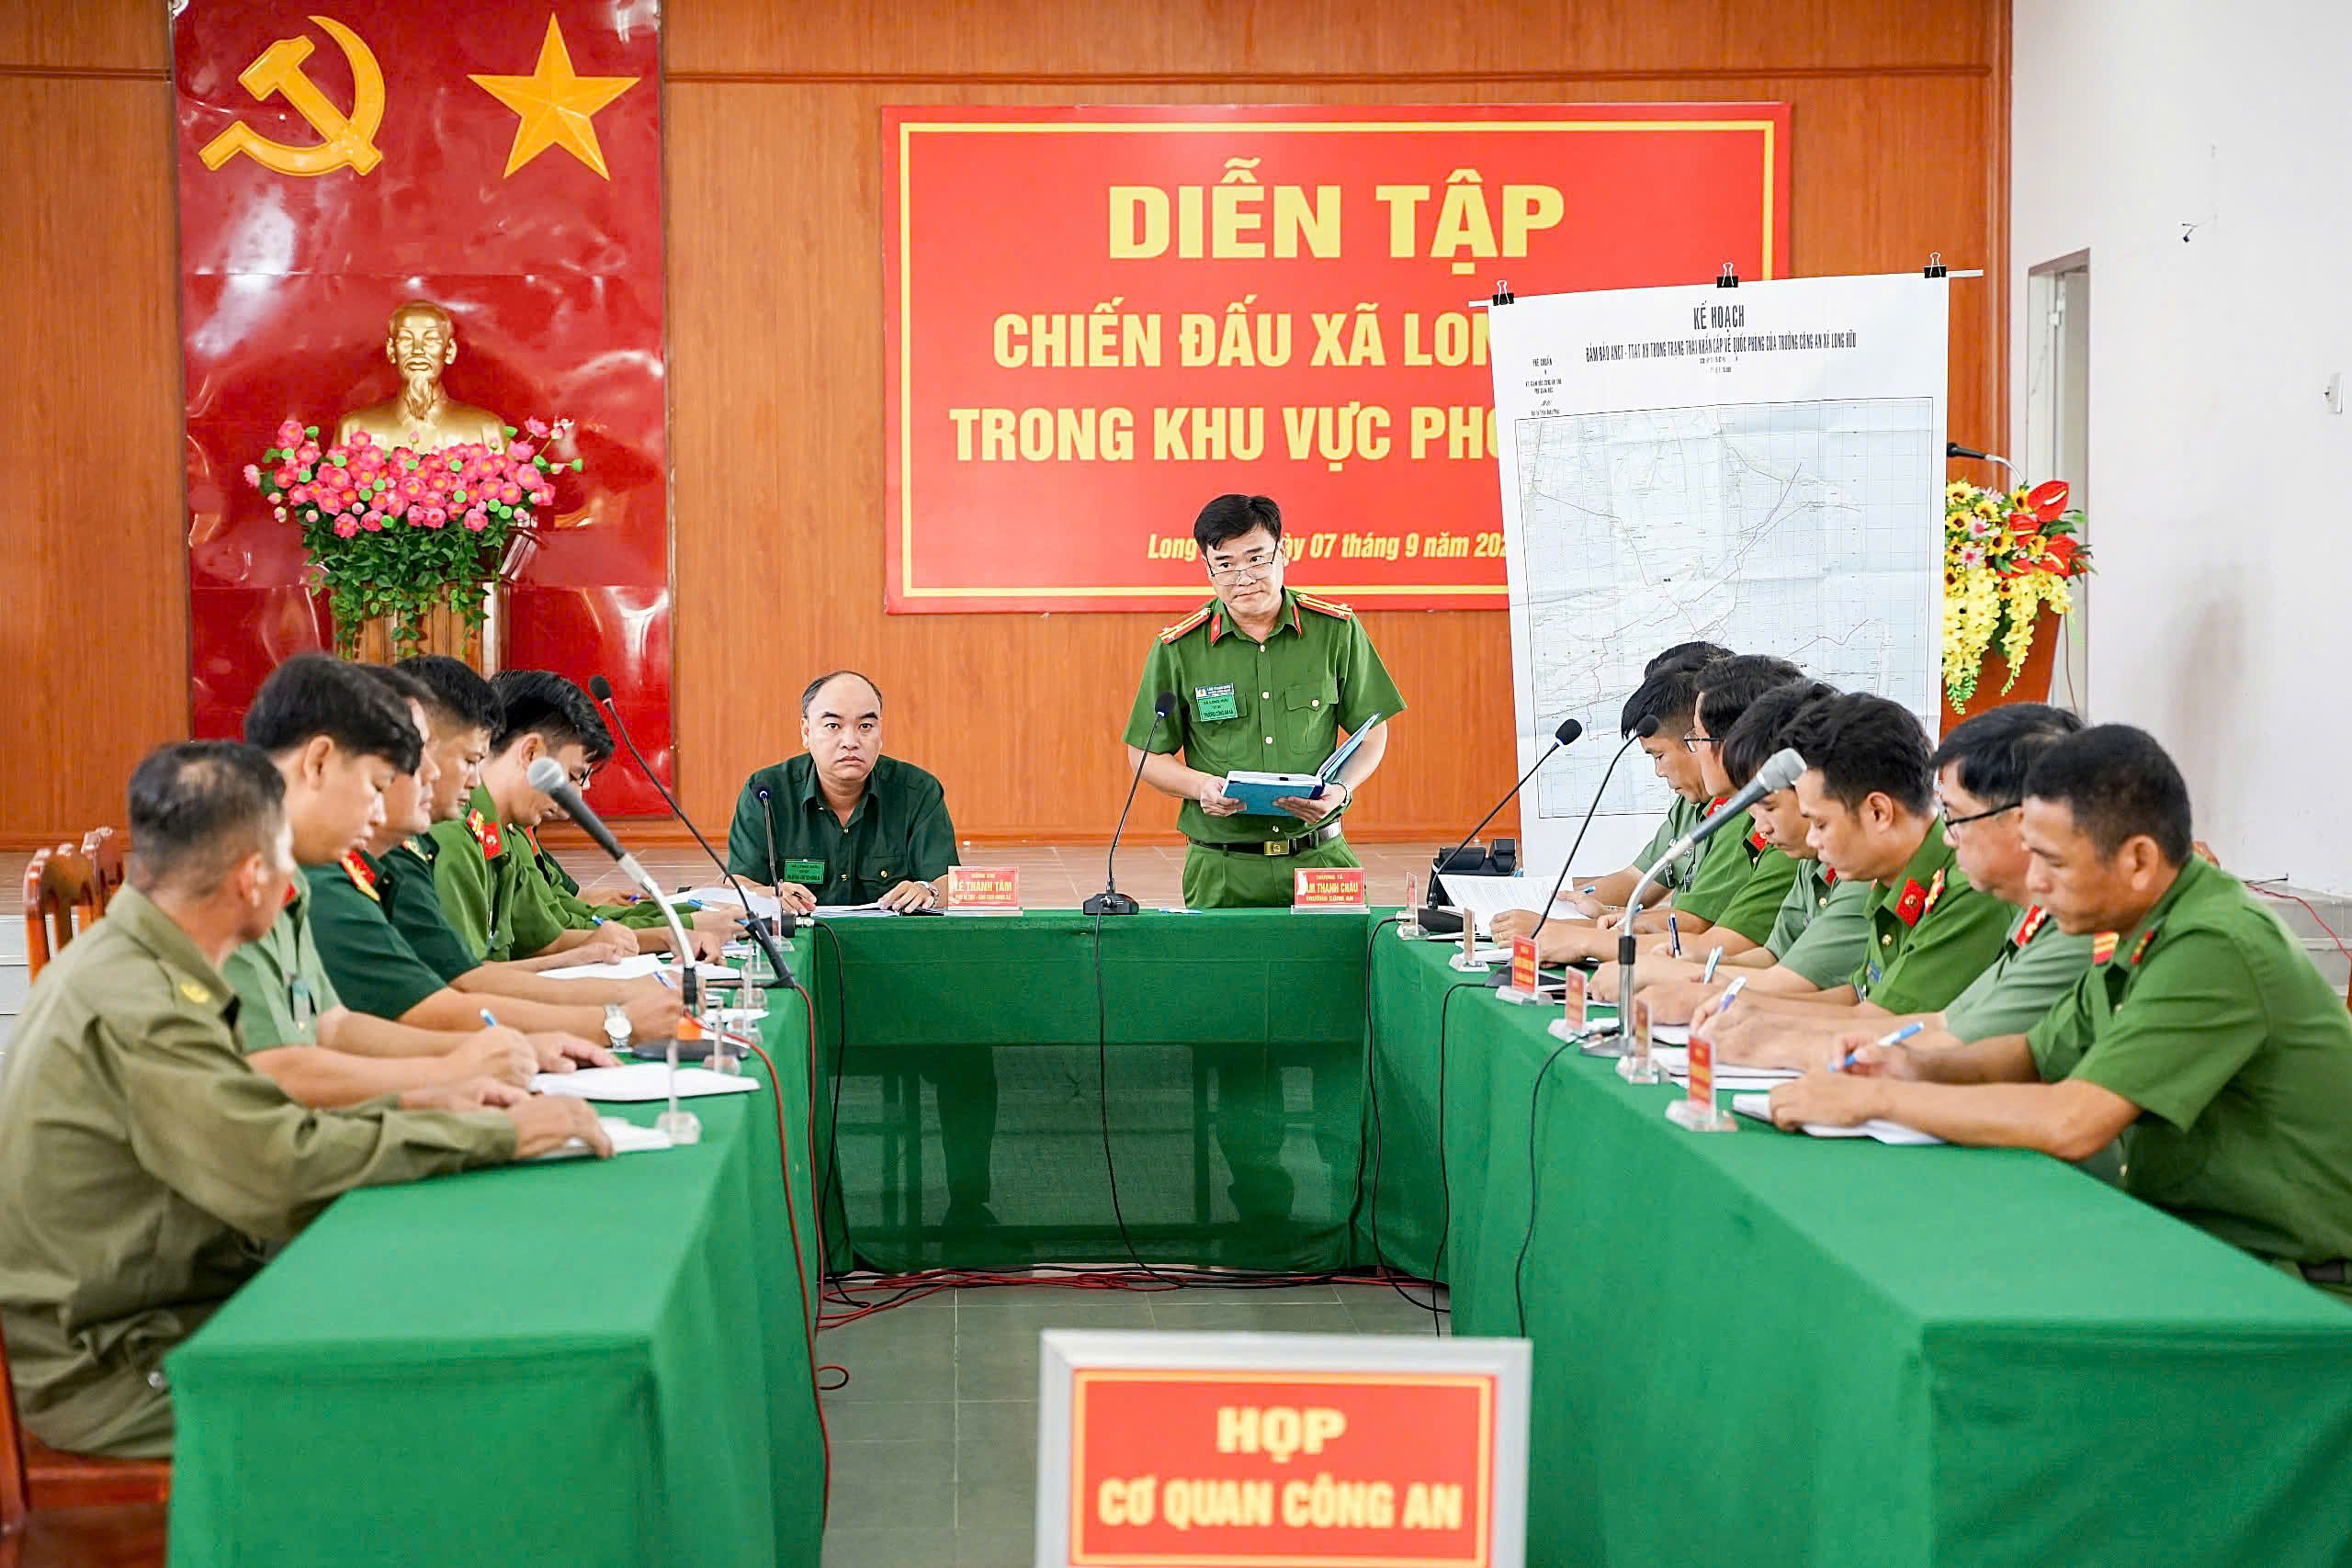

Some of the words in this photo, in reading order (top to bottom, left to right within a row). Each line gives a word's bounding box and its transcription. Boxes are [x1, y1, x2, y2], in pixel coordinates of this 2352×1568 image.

[1109, 157, 1341, 259] DIỄN
[1375, 168, 1565, 275] TẬP
[993, 296, 1161, 367] CHIẾN
[1179, 294, 1292, 367] ĐẤU
[1311, 301, 1386, 367] XÃ
[1404, 311, 1491, 367] LON
[1650, 341, 1667, 358] TRONG
[1815, 333, 1823, 349] AN
[1832, 332, 1845, 349] LONG
[1693, 300, 1708, 331] KẾ
[1711, 304, 1745, 333] HOẠCH
[948, 407, 1135, 462] TRONG
[1153, 407, 1265, 461] KHU
[1283, 400, 1391, 472] VỰC
[1147, 533, 1198, 562] Long
[1310, 533, 1338, 558] 07
[1341, 532, 1400, 561] tháng
[1405, 532, 1419, 558] 9
[1422, 531, 1470, 558] năm
[1216, 1406, 1346, 1463] HỌP
[1098, 1475, 1158, 1526] CƠ
[1163, 1479, 1274, 1530] QUAN
[1282, 1472, 1395, 1529] CÔNG
[1402, 1482, 1464, 1529] AN
